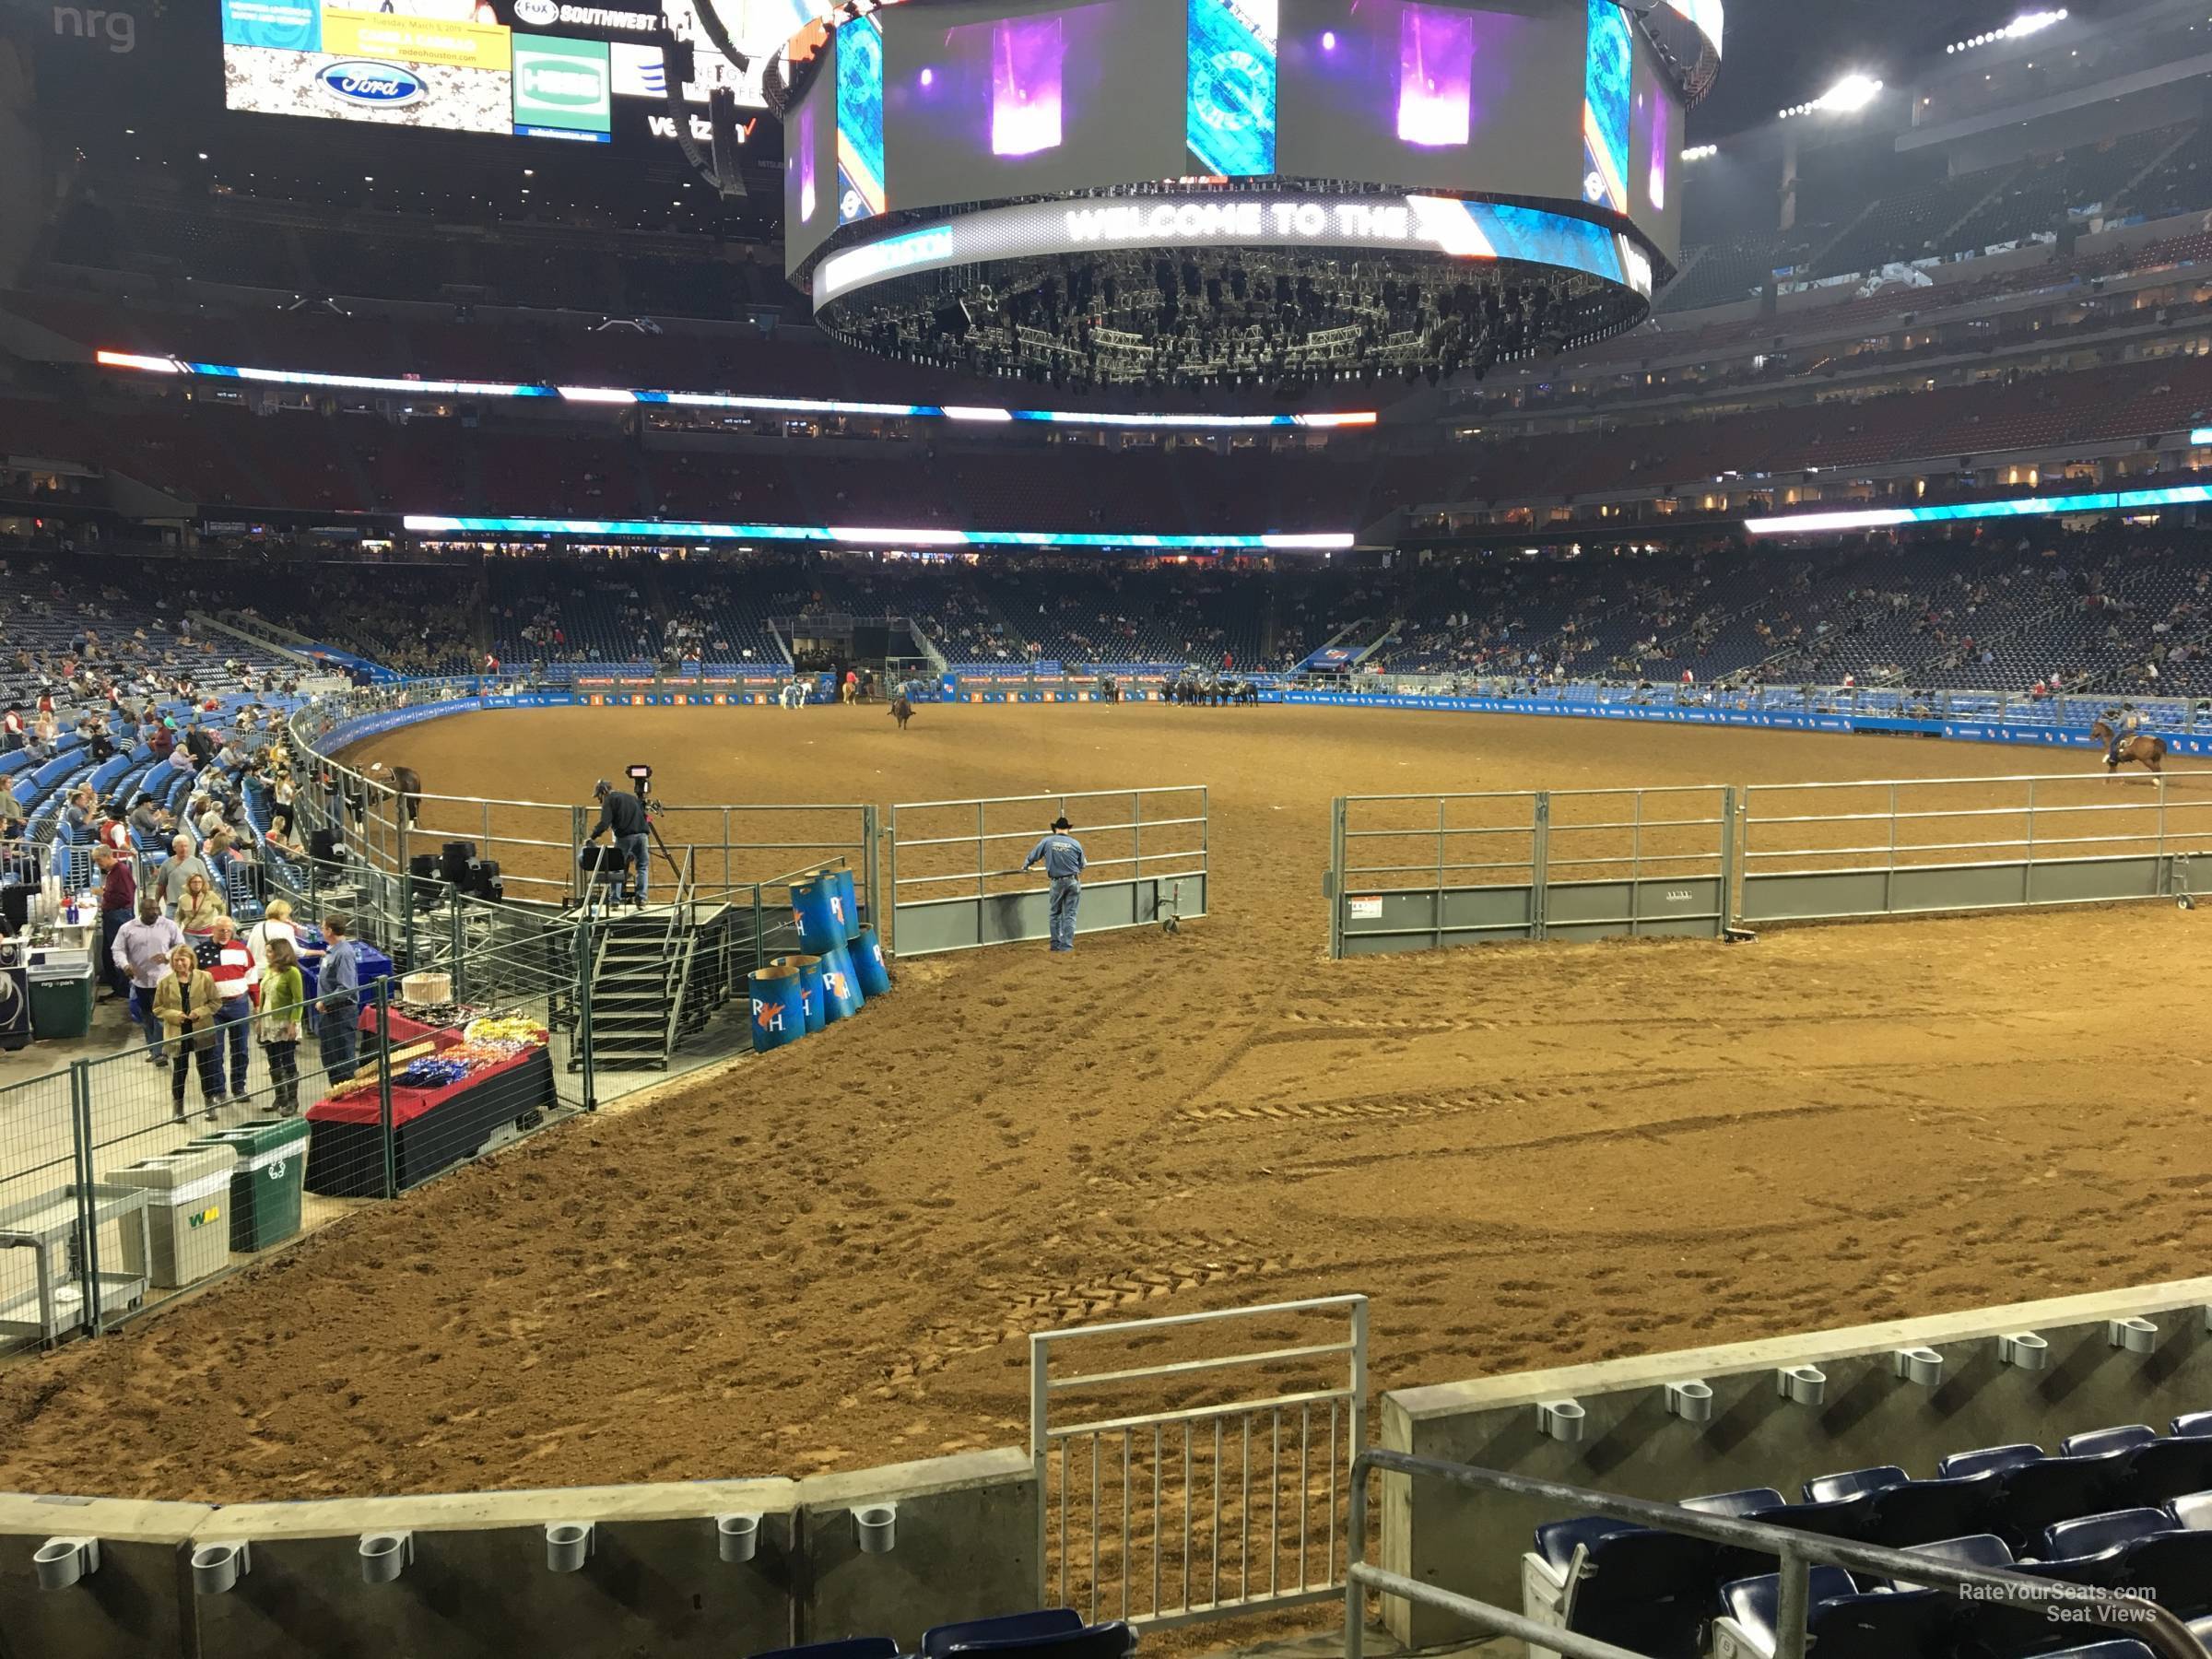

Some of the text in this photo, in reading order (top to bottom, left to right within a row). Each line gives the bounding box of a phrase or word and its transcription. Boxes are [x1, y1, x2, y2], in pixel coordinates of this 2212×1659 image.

[372, 17, 406, 29] Tuesday,
[409, 21, 434, 30] March
[524, 1, 655, 30] FOX SOUTHWEST
[53, 6, 135, 53] nrg
[398, 48, 477, 63] rodeohouston.com
[342, 72, 399, 96] Ford
[1065, 203, 1408, 241] WELCOME TO THE
[822, 973, 836, 991] R
[752, 998, 782, 1032] R H
